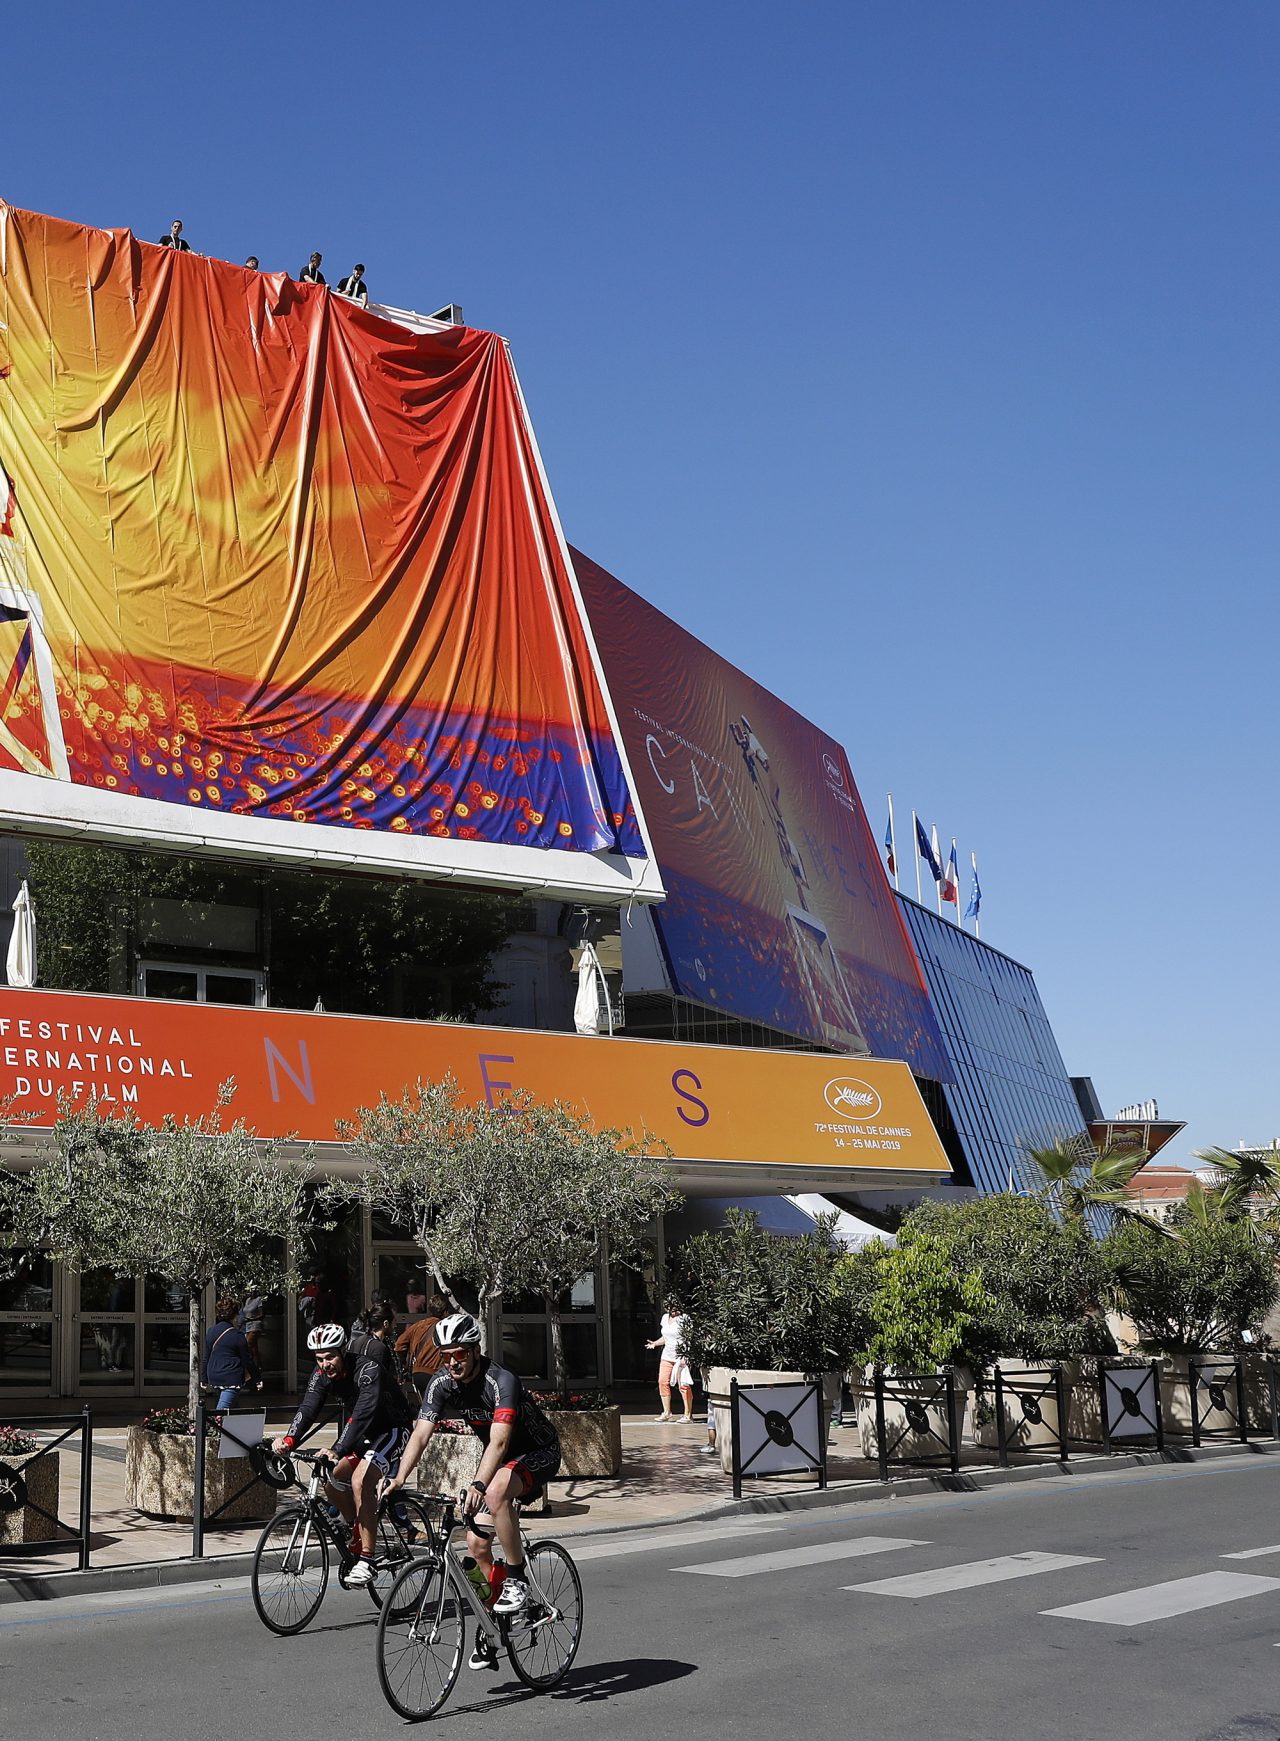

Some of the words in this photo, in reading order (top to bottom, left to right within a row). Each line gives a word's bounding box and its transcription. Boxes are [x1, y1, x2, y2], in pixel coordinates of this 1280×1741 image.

[0, 1018, 142, 1047] FESTIVAL
[16, 1077, 53, 1097] DU
[72, 1080, 138, 1103] FILM
[828, 1124, 867, 1135] FESTIVAL
[867, 1126, 878, 1135] DE
[879, 1127, 912, 1137] CANNES
[834, 1138, 845, 1147] 14
[852, 1139, 863, 1148] 25
[864, 1139, 880, 1149] MAI
[882, 1140, 901, 1150] 2019
